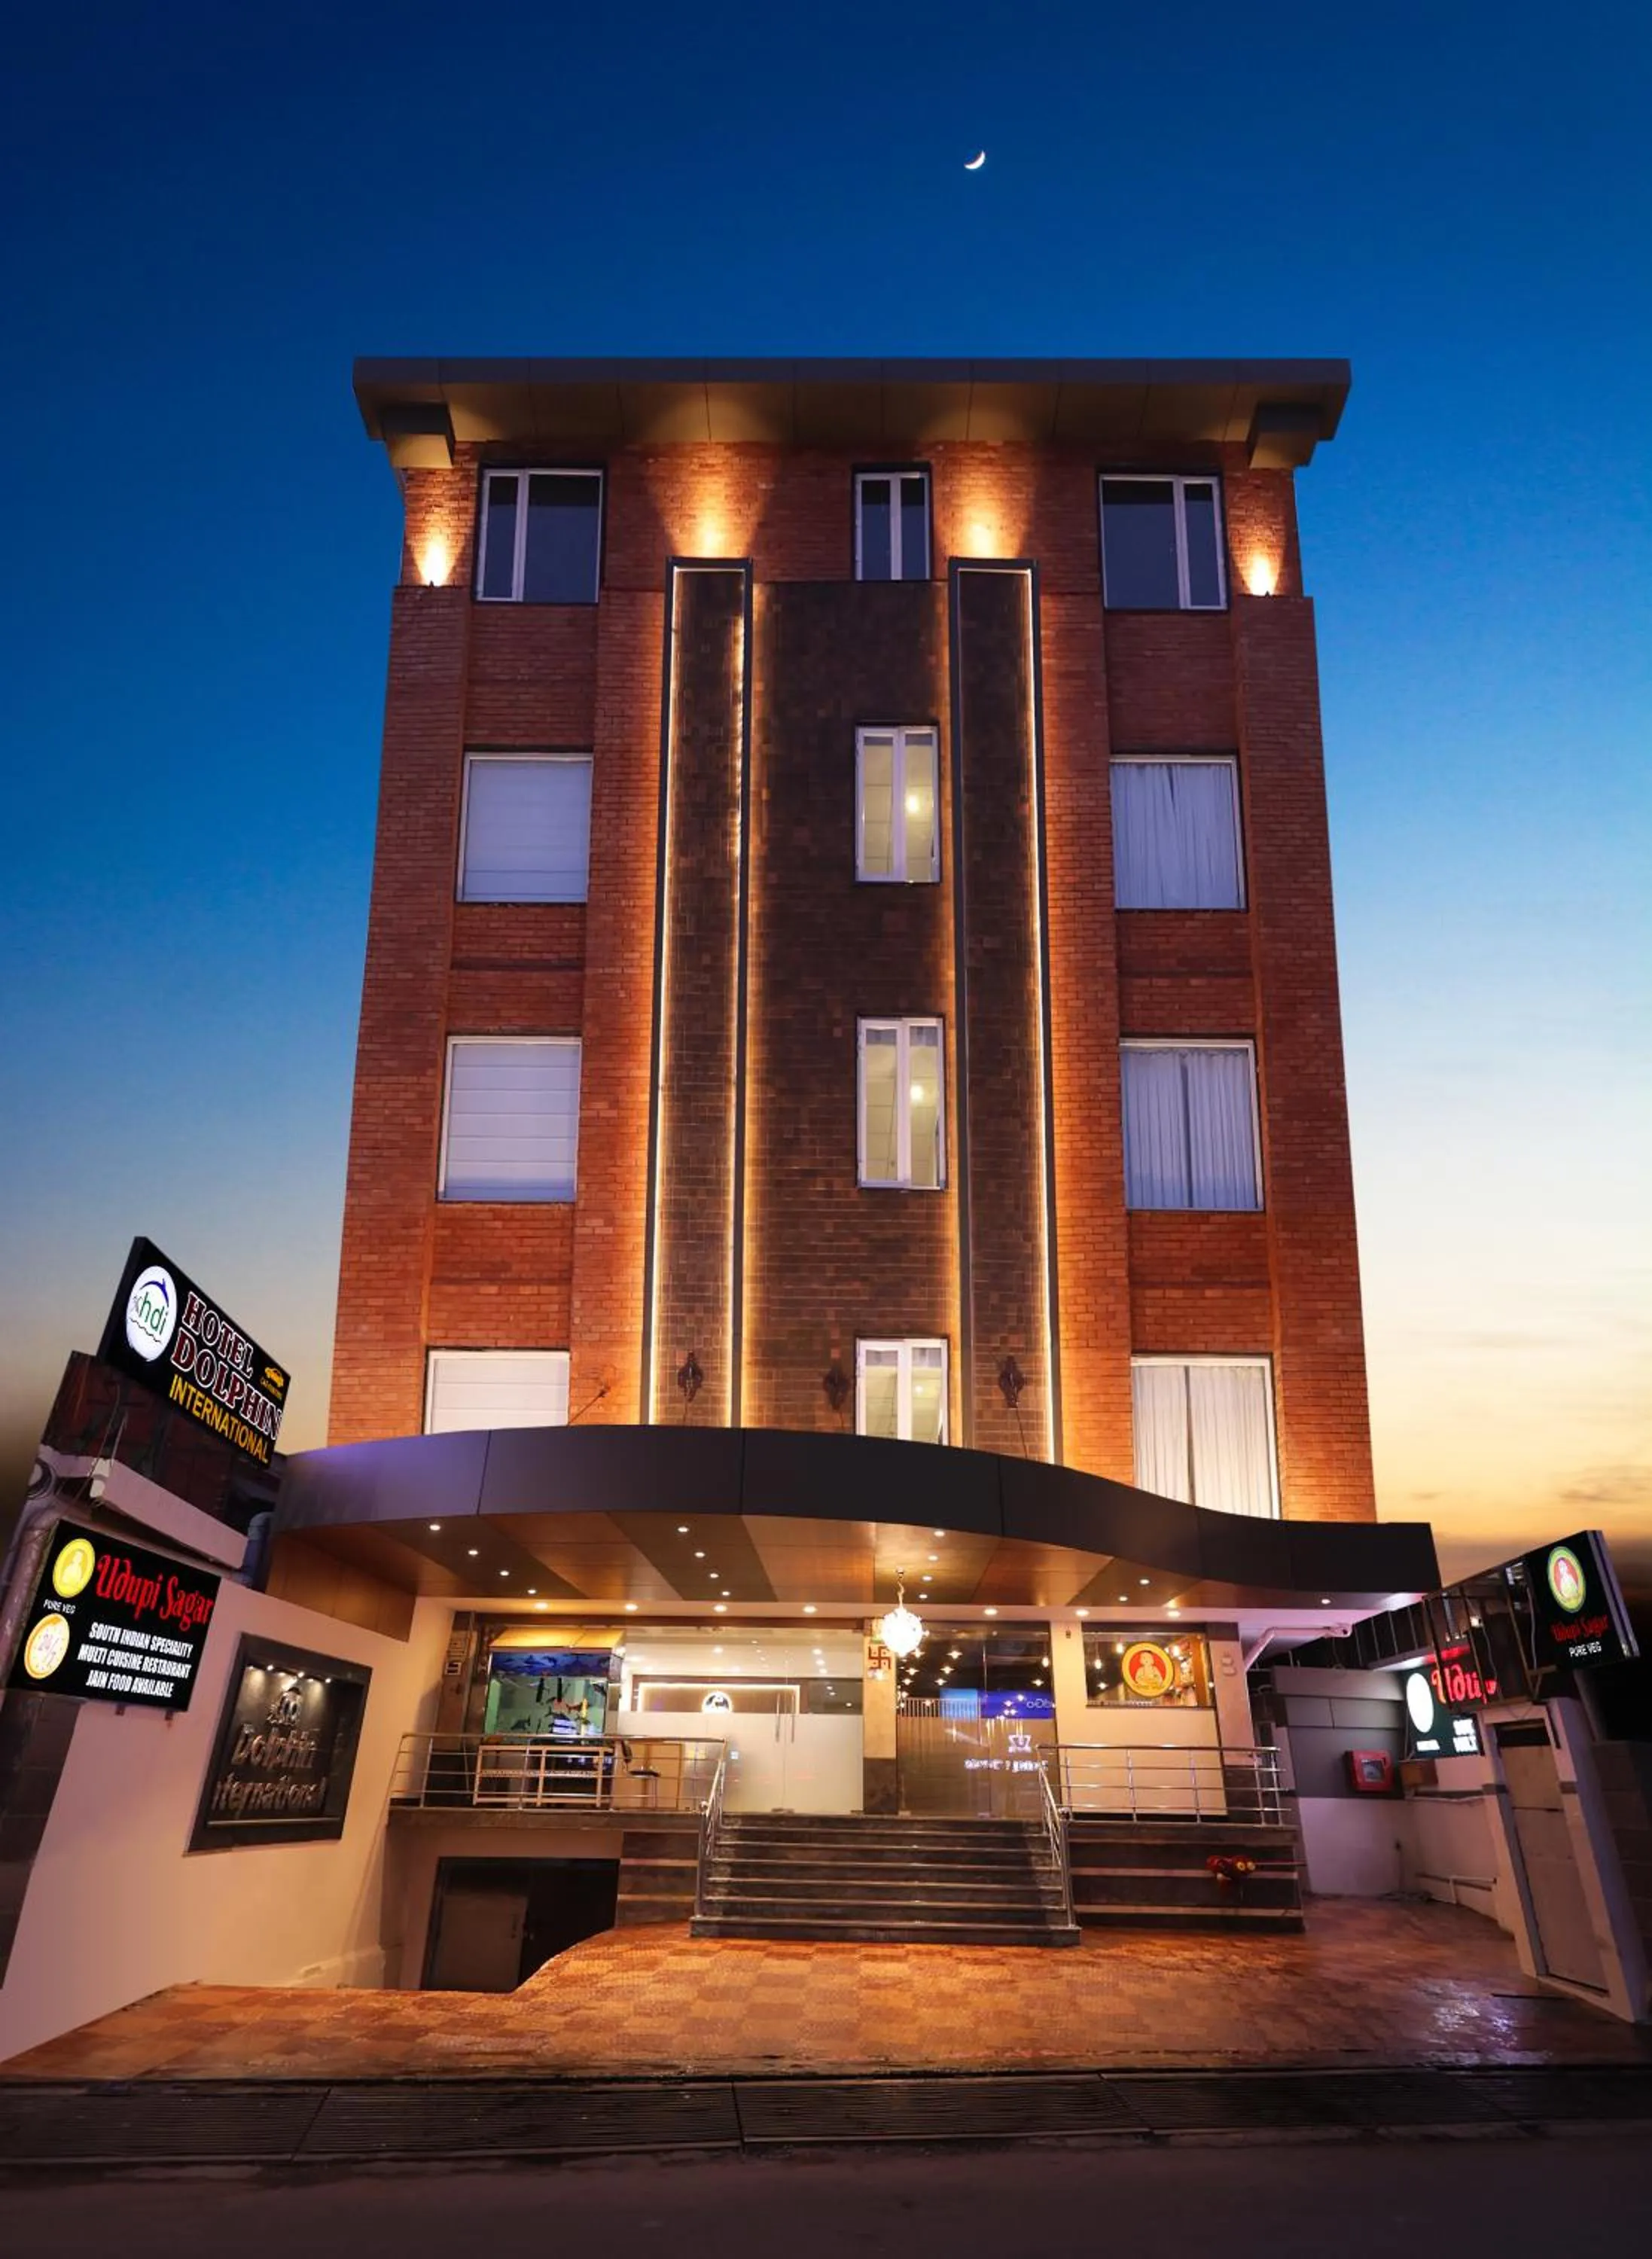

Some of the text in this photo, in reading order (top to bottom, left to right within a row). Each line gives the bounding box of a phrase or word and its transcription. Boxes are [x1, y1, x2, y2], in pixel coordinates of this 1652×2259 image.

[182, 1291, 254, 1379] HOTEL
[170, 1327, 283, 1440] DOLPHIN
[169, 1373, 269, 1464] INTERNATIONAL
[43, 1599, 76, 1614] PURE VEG
[96, 1553, 214, 1631] Udupi Sagar
[77, 1643, 192, 1679] MULTI CUISINE RESTAURANT
[89, 1621, 194, 1658] SOUTH INDIAN SPECIALITY
[85, 1669, 175, 1698] JAIN FOOD AVAILABLE
